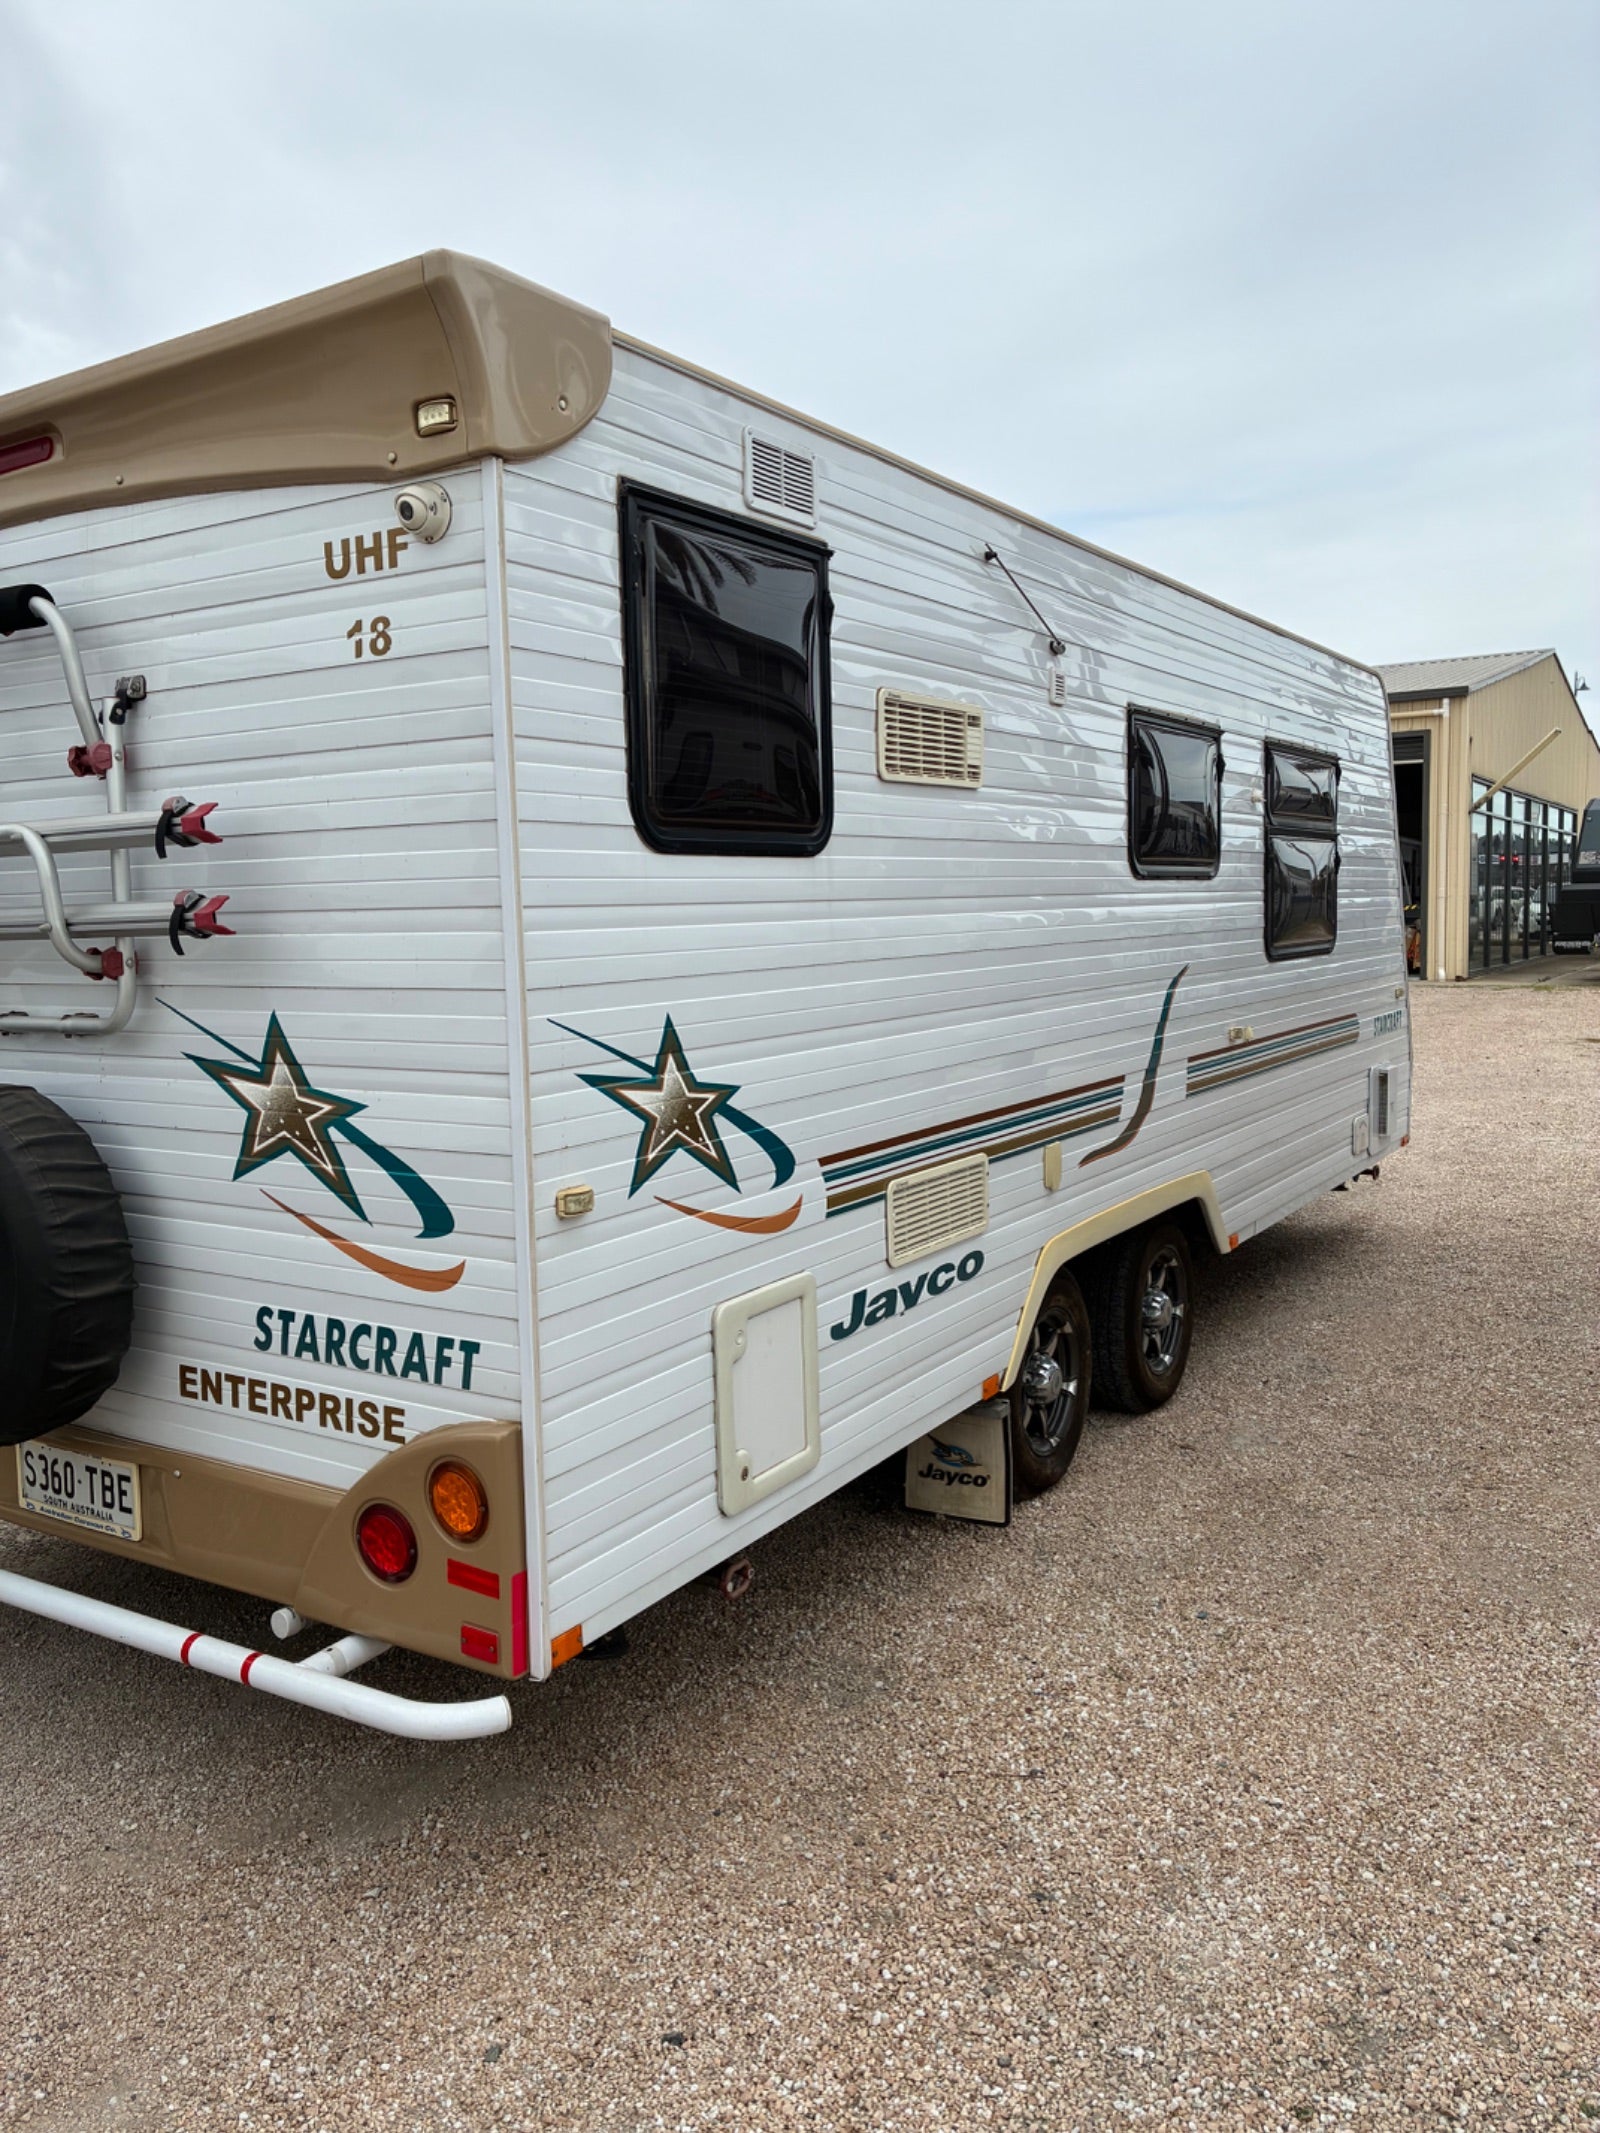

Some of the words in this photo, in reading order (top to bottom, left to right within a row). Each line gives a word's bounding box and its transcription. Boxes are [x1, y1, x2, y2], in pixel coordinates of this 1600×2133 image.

[323, 527, 409, 580] UHF
[346, 615, 392, 659] 18
[830, 1249, 985, 1341] Jayco
[253, 1305, 481, 1391] STARCRAFT
[178, 1363, 406, 1445] ENTERPRISE
[918, 1462, 988, 1488] Jayco
[42, 1493, 68, 1512] SOUTH
[70, 1502, 114, 1523] AUSTRALIA
